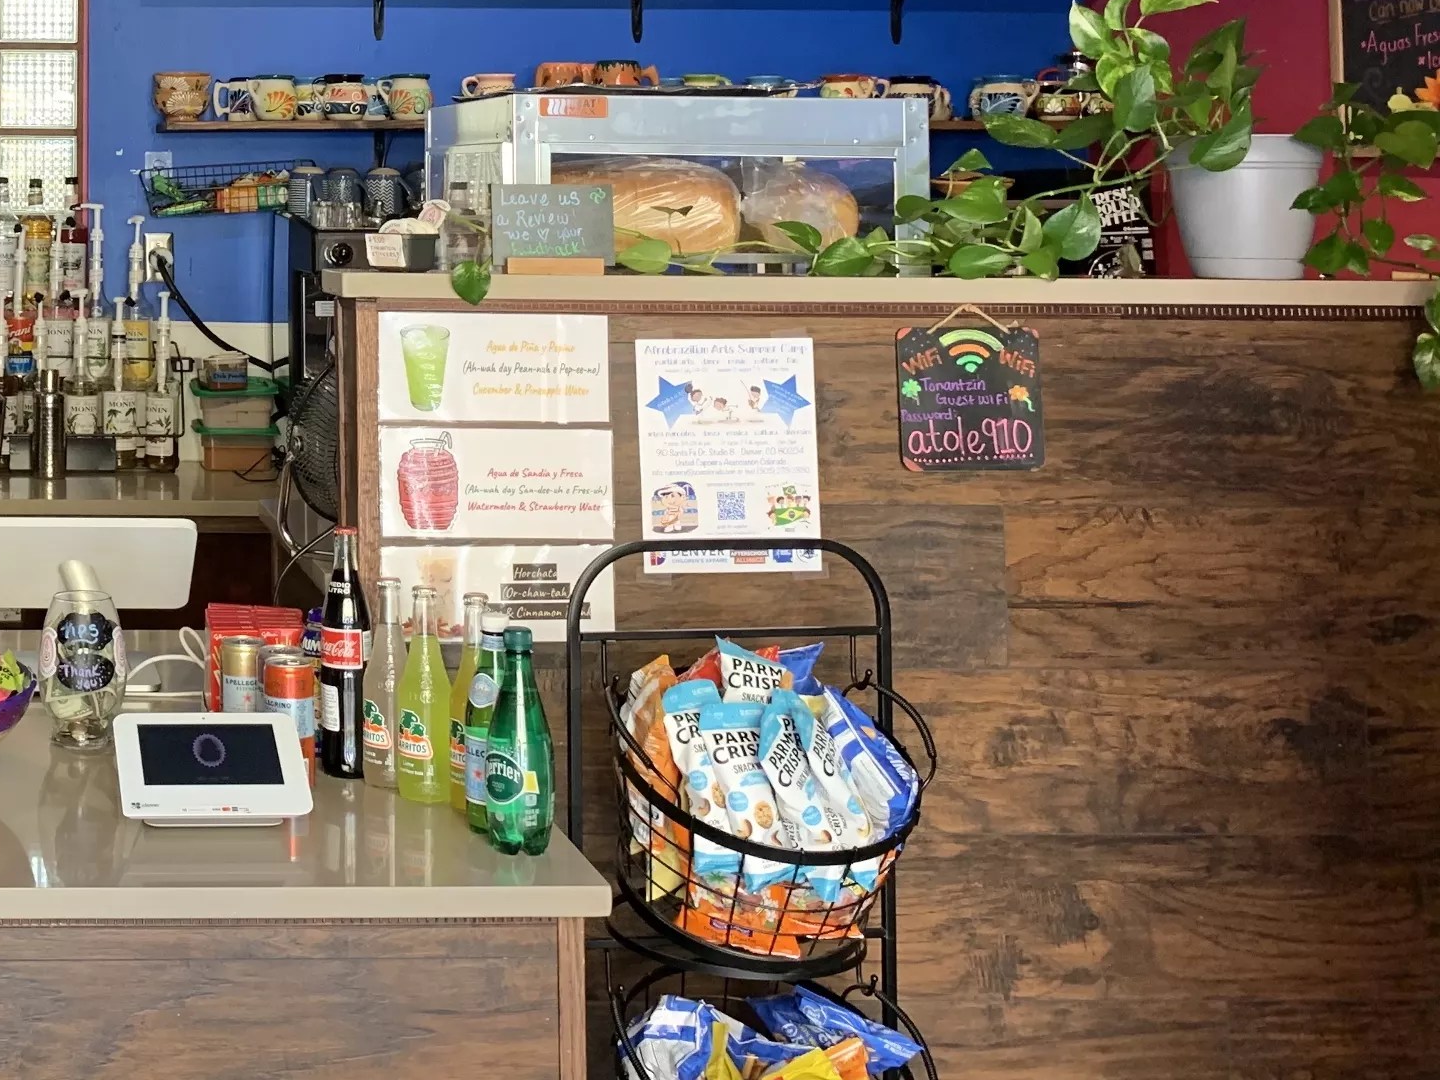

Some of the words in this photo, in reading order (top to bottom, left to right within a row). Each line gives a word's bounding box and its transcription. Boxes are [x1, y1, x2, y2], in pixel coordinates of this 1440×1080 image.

[1365, 30, 1412, 71] Aguas
[500, 189, 550, 207] Leave
[558, 191, 581, 206] us
[496, 214, 509, 226] a
[498, 363, 512, 376] day
[919, 377, 987, 392] Tonantzin
[935, 393, 975, 407] Guest
[907, 415, 1033, 456] atole910
[487, 468, 508, 480] Agua
[509, 468, 519, 477] de
[552, 471, 559, 480] y
[559, 469, 584, 478] Fresa
[464, 484, 500, 495] (Ah-wah
[502, 485, 516, 496] day
[467, 501, 516, 512] Watermelon
[518, 502, 526, 512] &
[528, 501, 577, 514] Strawberry
[514, 566, 558, 580] Horchata
[517, 606, 562, 619] Cinnamon
[59, 664, 101, 679] Thank
[731, 657, 783, 681] PARM
